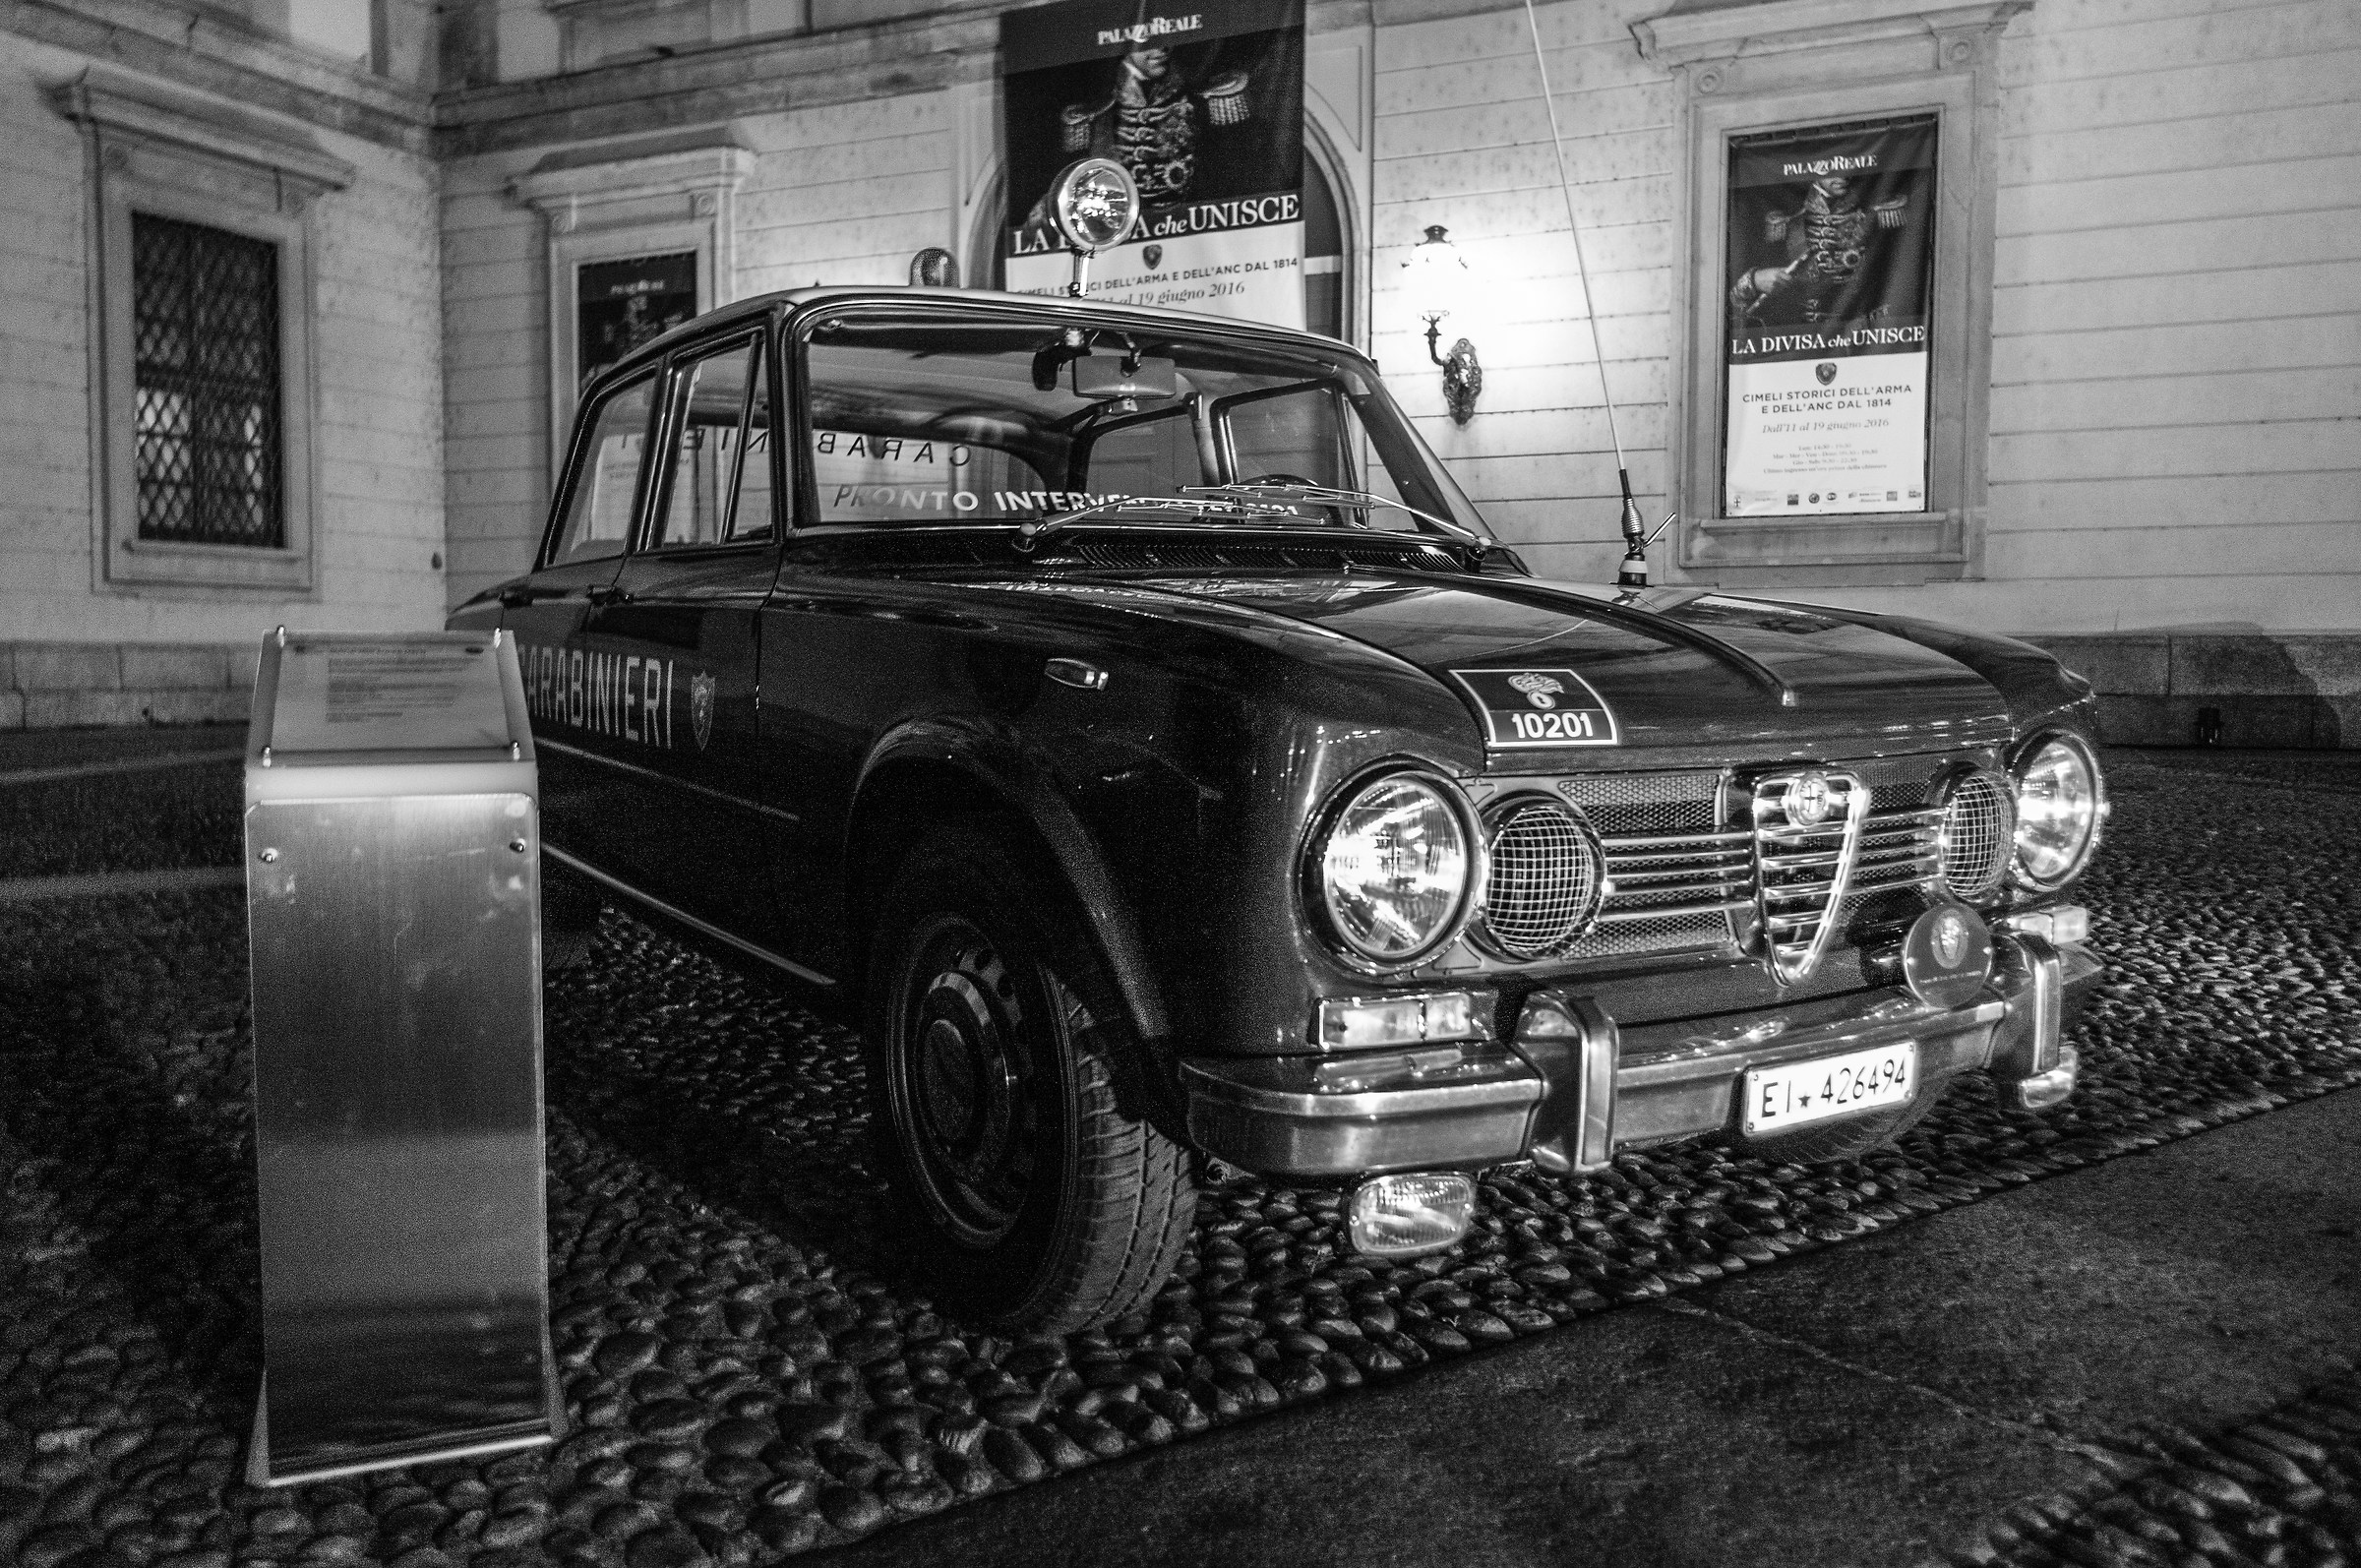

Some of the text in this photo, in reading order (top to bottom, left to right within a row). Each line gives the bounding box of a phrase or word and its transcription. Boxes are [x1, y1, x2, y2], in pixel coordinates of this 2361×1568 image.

[1013, 228, 1050, 254] LA
[1154, 215, 1188, 236] che
[1188, 194, 1300, 231] UNISCE
[1105, 272, 1169, 289] DELL'ARMA
[1173, 271, 1179, 281] E
[1182, 264, 1241, 279] DELL'ANC
[1244, 261, 1269, 272] DAL
[1273, 257, 1298, 270] 1814
[1138, 291, 1154, 307] 19
[1157, 288, 1205, 306] giugno
[1208, 280, 1245, 298] 2016
[1731, 326, 1925, 354] LA DIVISA che UNISCE
[1742, 384, 1912, 403] CIMELI STORICI DELL'ARMA
[1761, 397, 1892, 414] E DELL'ANC DAL 1814
[1799, 422, 1809, 432] al
[1813, 421, 1825, 431] 19
[1826, 420, 1861, 432] giugno
[1863, 418, 1890, 429] 2016
[833, 484, 979, 511] PRONTO
[1511, 712, 1594, 739] 10201
